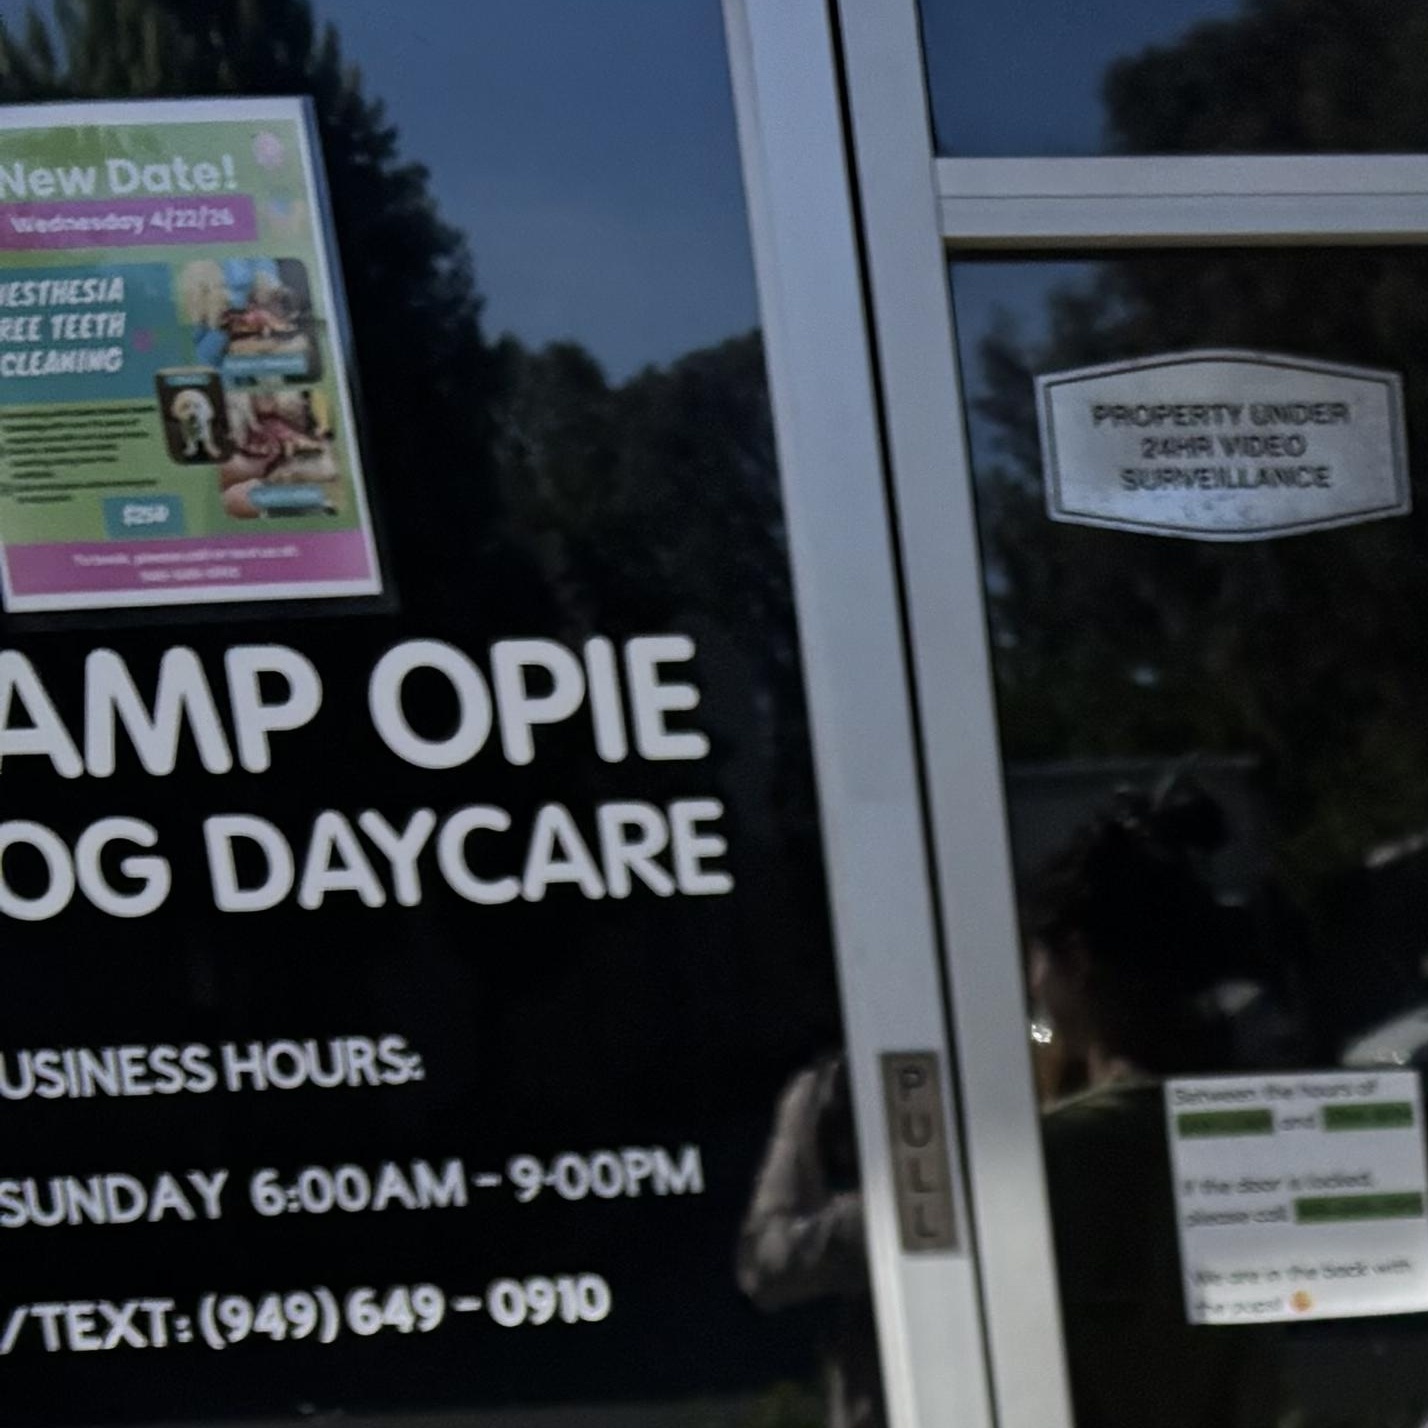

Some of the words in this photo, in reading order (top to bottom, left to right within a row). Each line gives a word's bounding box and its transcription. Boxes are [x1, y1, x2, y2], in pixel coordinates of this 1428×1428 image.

[0, 161, 97, 198] New
[105, 153, 238, 195] Date!
[10, 213, 145, 236] Wednesday
[51, 312, 127, 340] TEETH
[1, 346, 124, 377] CLEANING
[1091, 402, 1246, 429] PROPERTY
[1250, 401, 1350, 427] UNDER
[1141, 434, 1214, 459] 24HR
[1220, 433, 1308, 458] VIDEO
[1119, 464, 1331, 491] SURVEILLANCE
[0, 644, 324, 779] AMP
[367, 634, 711, 770] OPIE
[0, 815, 173, 921] OG
[202, 797, 735, 913] DAYCARE
[0, 1043, 218, 1101] USINESS
[221, 1034, 427, 1093] HOURS:
[896, 1062, 943, 1239] PULL
[0, 1169, 230, 1229] SUNDAY
[250, 1157, 469, 1217] 6:00AM
[486, 1271, 611, 1328] 0910
